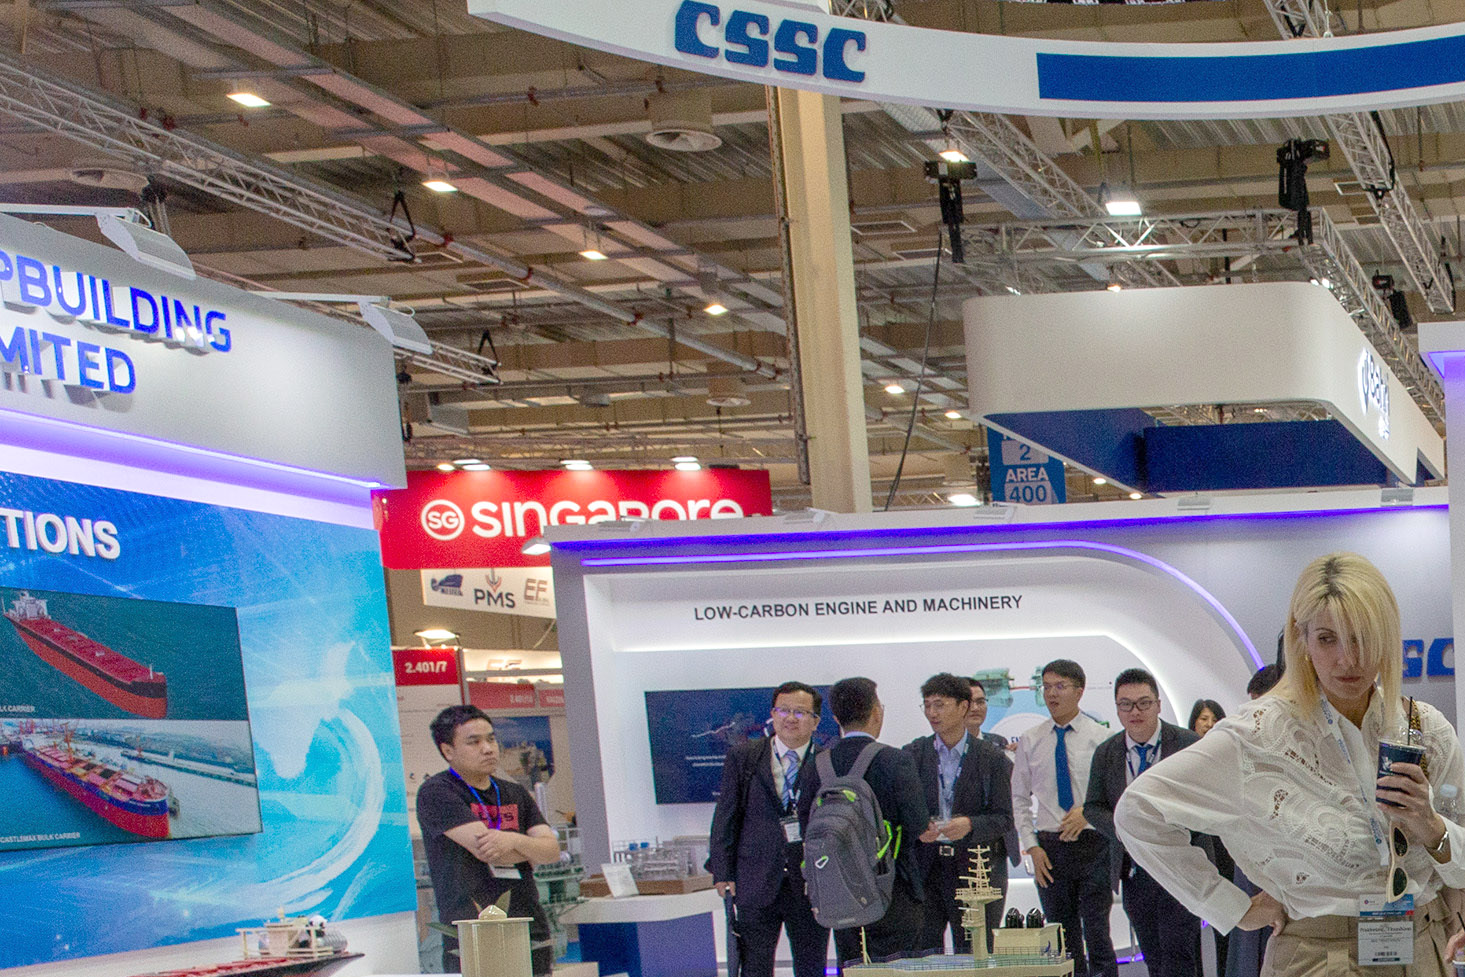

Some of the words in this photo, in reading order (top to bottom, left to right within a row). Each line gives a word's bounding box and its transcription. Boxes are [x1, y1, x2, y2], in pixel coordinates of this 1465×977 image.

[675, 0, 867, 83] CSSC
[1019, 444, 1031, 461] 2
[1006, 466, 1049, 482] AREA
[1009, 485, 1047, 503] 400
[428, 511, 459, 529] SG
[474, 588, 516, 609] PMS
[695, 602, 810, 621] LOW-CARBON
[815, 600, 878, 616] ENGINE
[883, 598, 918, 613] AND
[923, 595, 1023, 612] MACHINERY
[1402, 637, 1455, 678] SC
